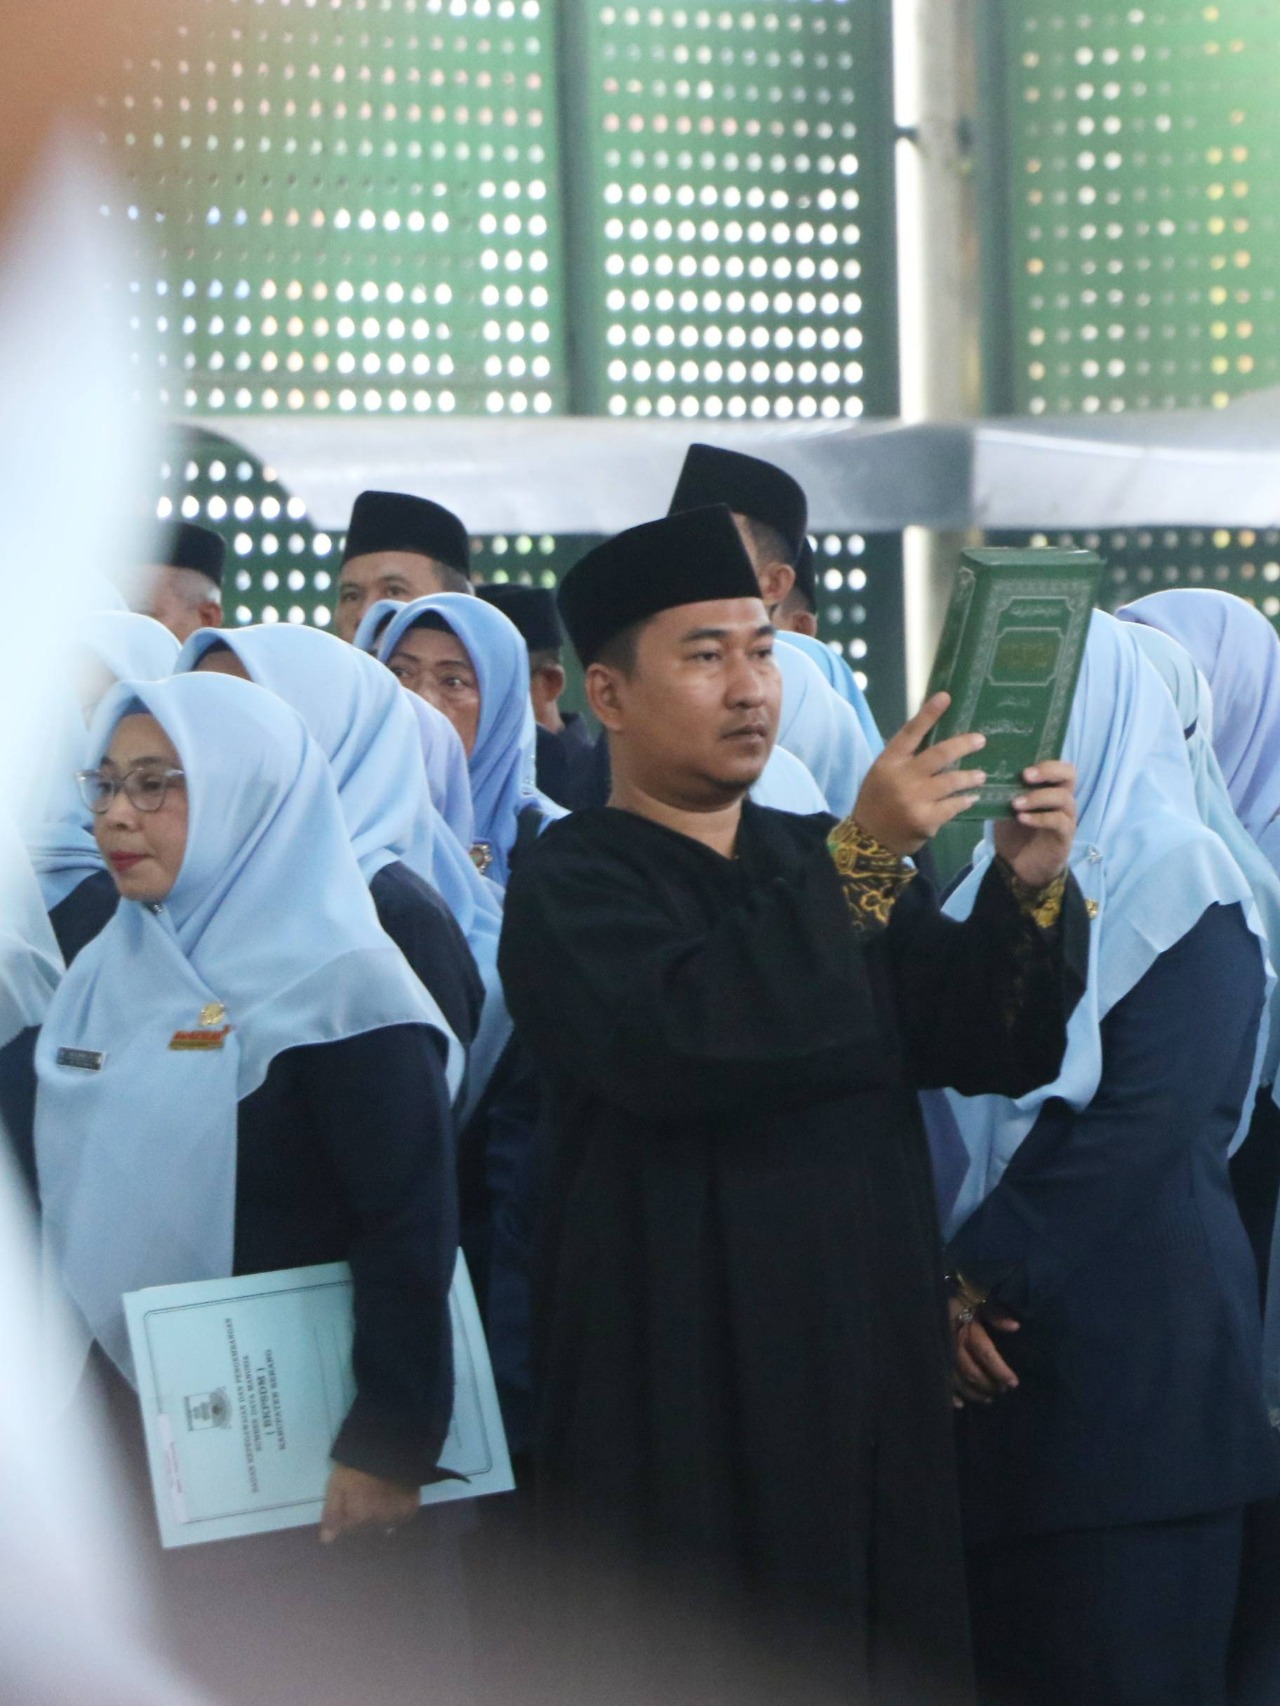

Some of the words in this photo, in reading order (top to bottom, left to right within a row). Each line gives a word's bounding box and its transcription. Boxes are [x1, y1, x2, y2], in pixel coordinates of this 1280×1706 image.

[264, 1348, 277, 1389] SERANG
[235, 1385, 245, 1402] DAN
[271, 1391, 286, 1450] KABUPATEN
